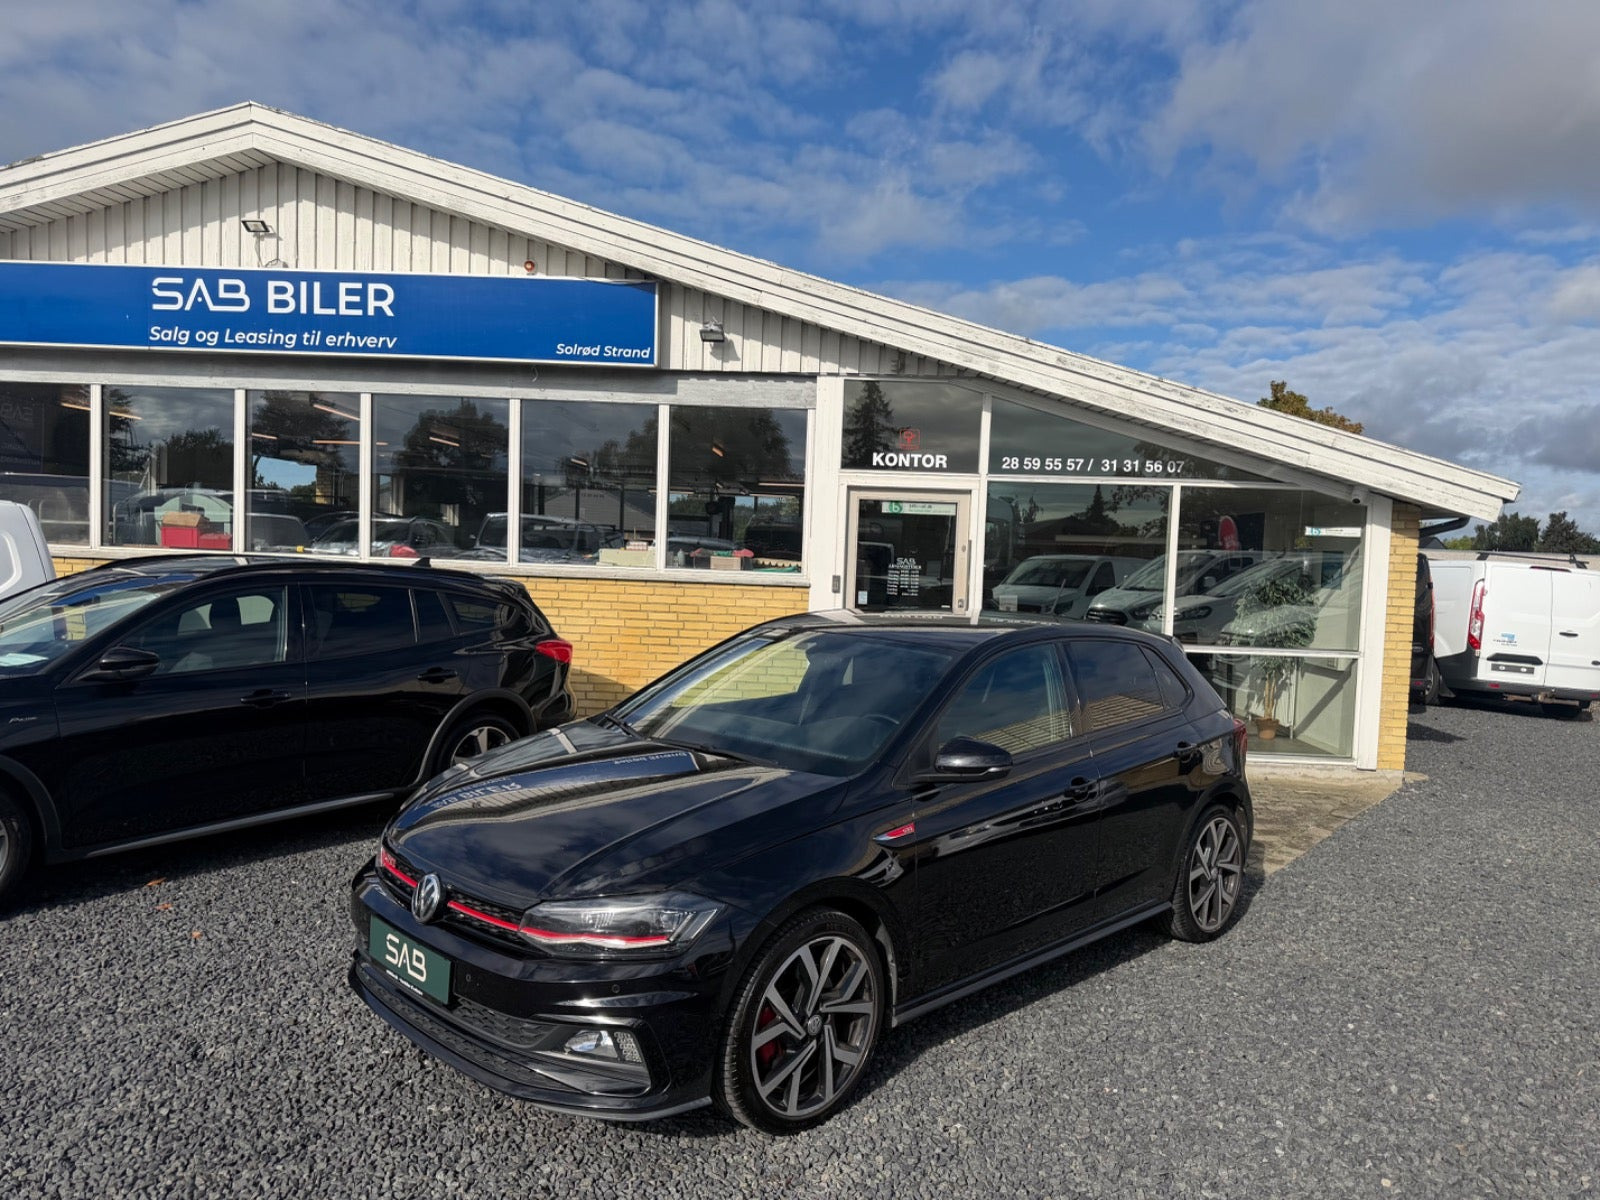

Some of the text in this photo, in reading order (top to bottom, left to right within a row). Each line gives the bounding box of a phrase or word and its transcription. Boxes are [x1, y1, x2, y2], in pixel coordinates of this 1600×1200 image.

[151, 277, 395, 317] SAB BILER
[149, 326, 398, 348] Salg og Leasing til erhverv
[555, 343, 651, 358] Solrød Strand
[872, 453, 949, 470] KONTOR
[1001, 456, 1020, 470] 28
[1023, 457, 1041, 470] 59
[1044, 457, 1062, 471] 55
[1066, 458, 1084, 472] 57
[1101, 459, 1117, 472] 31
[1123, 459, 1139, 473] 31
[1144, 460, 1163, 473] 56
[1166, 460, 1185, 473] 07
[385, 933, 427, 982] SAB
